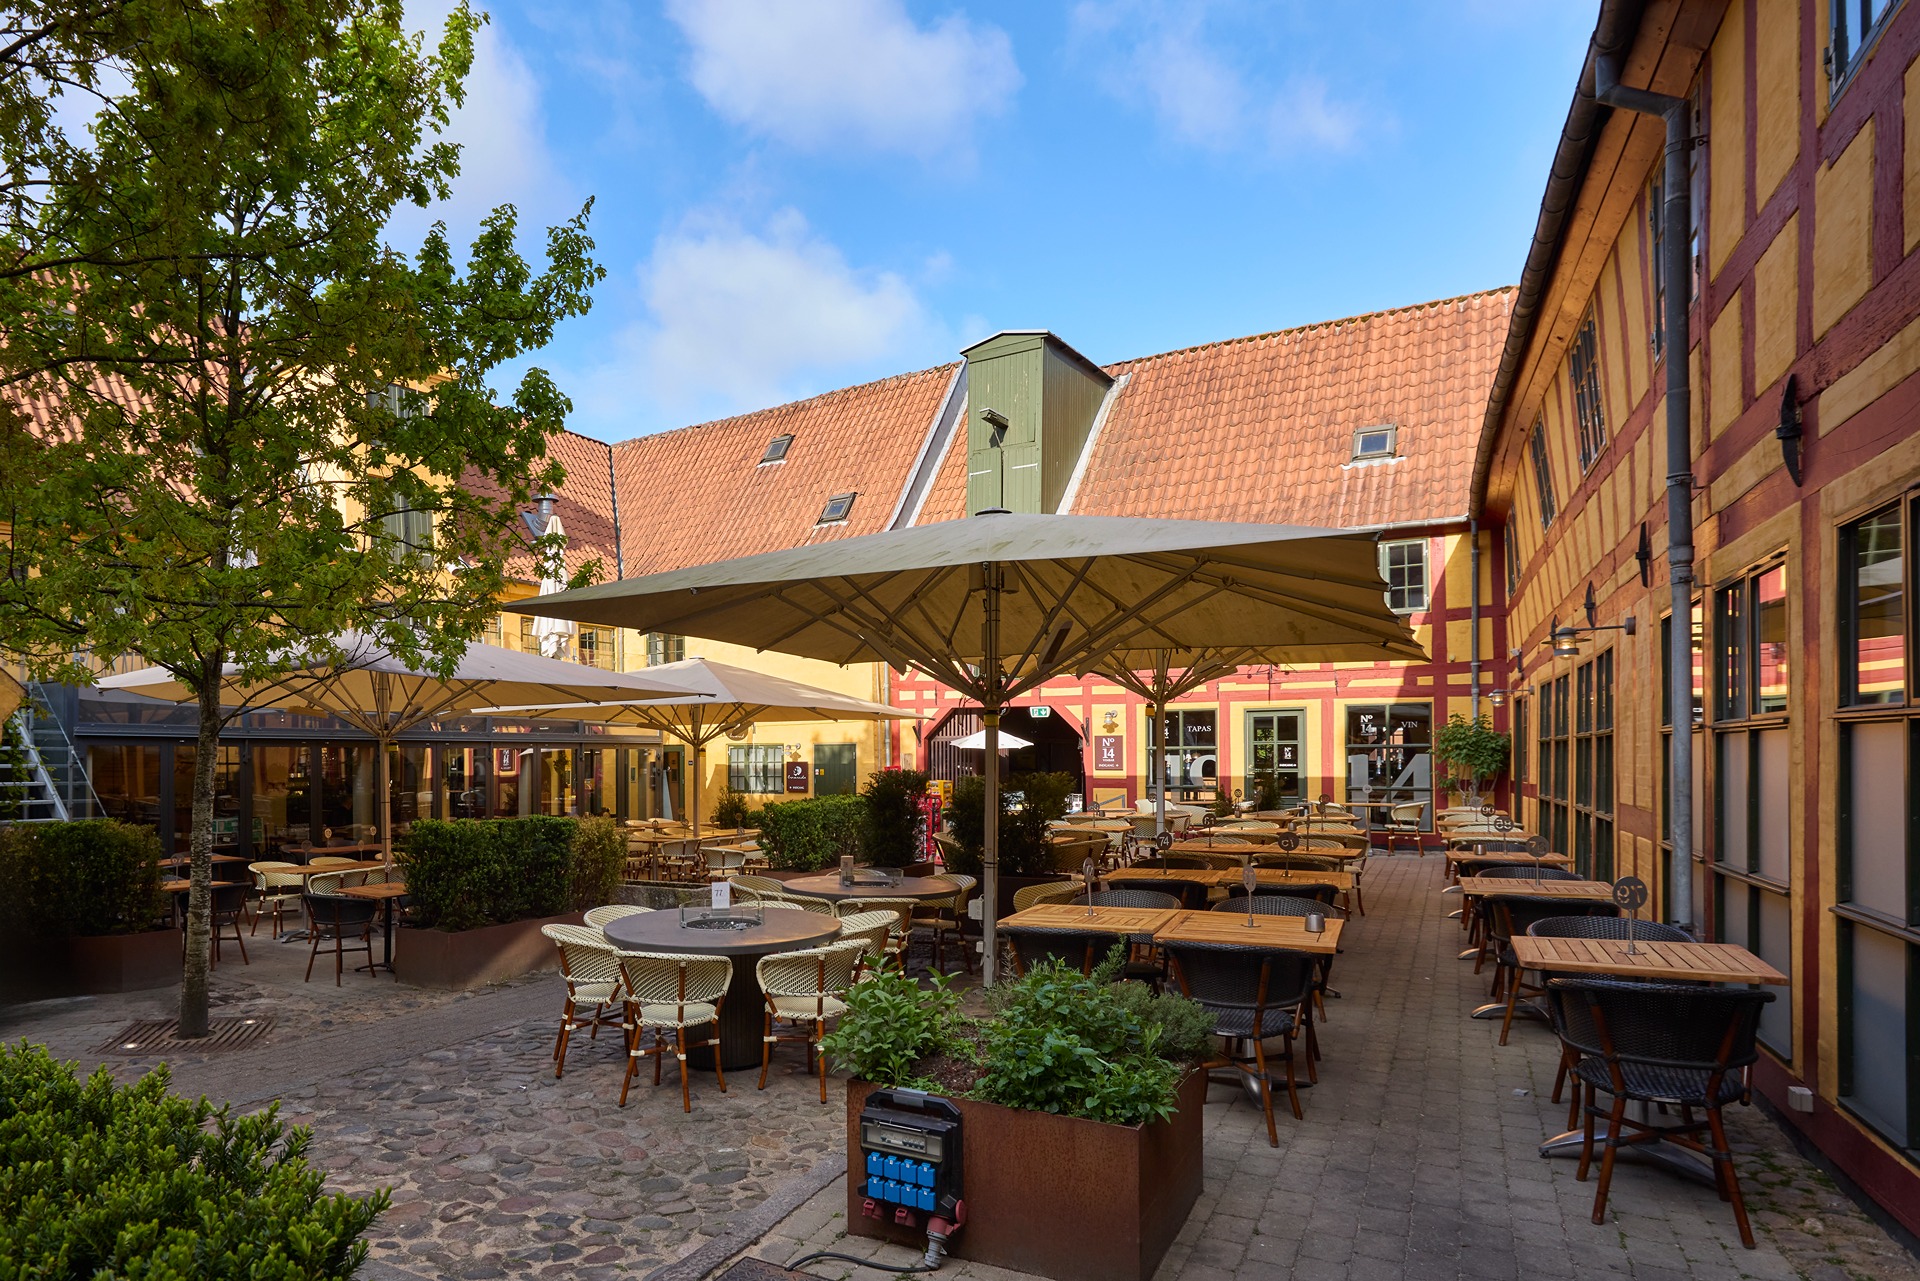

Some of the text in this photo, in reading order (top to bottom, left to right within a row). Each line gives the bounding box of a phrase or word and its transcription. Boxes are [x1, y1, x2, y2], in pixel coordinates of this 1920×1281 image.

[1360, 724, 1372, 734] 14
[1102, 748, 1115, 759] 14
[1347, 753, 1430, 830] 14
[1159, 836, 1170, 847] 74
[714, 889, 723, 897] 77
